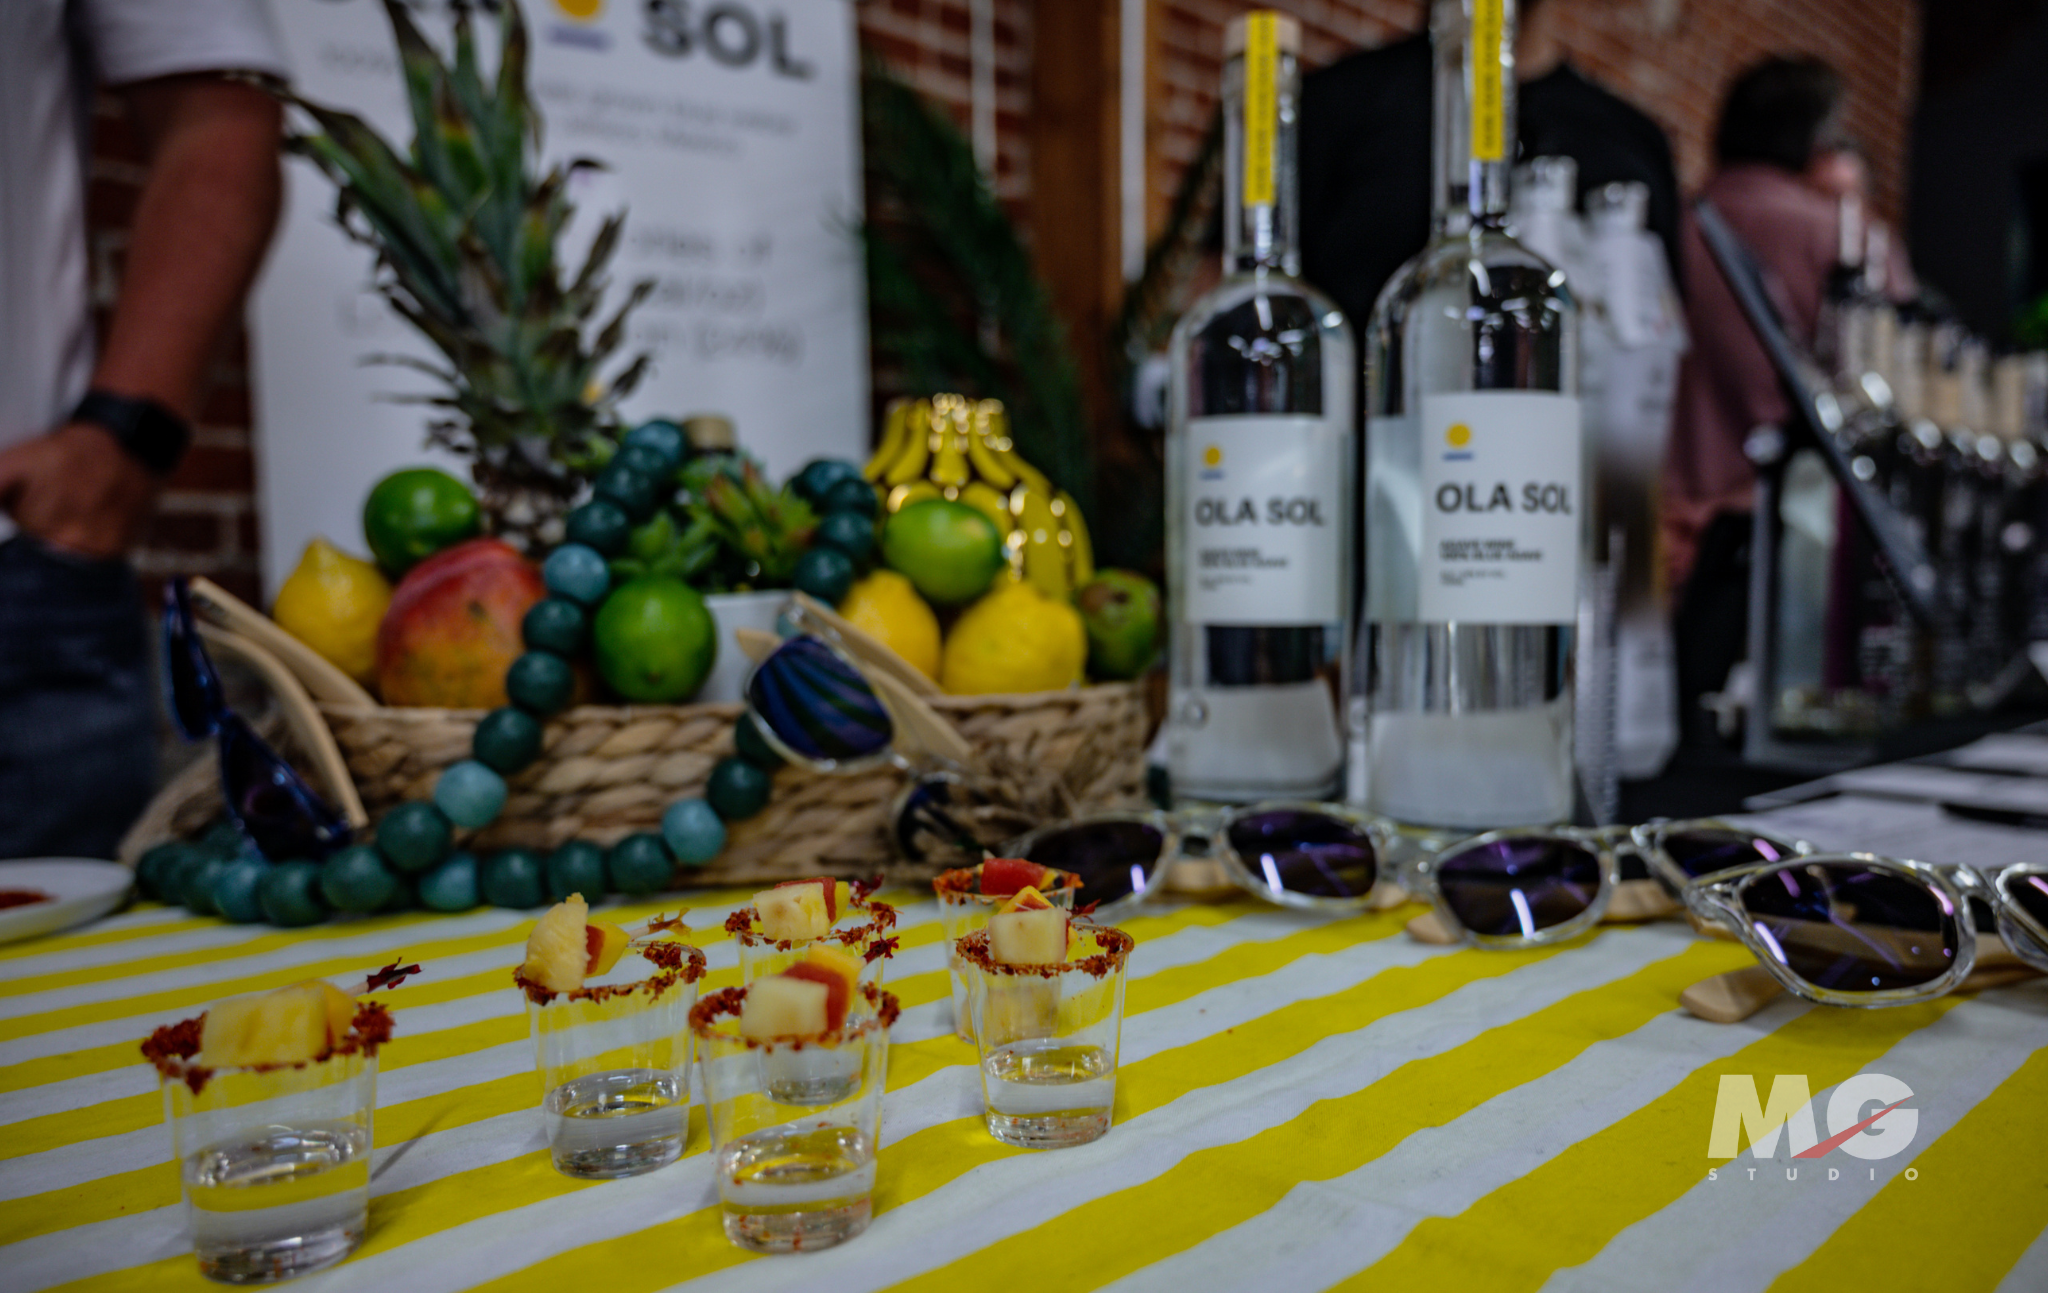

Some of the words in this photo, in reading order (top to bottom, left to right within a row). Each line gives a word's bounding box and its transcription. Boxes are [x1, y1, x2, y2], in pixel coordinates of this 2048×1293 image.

[640, 0, 818, 80] SOL
[1195, 498, 1258, 527] OLA
[1266, 499, 1325, 527] SOL
[1436, 483, 1515, 514] OLA
[1522, 482, 1573, 515] SOL
